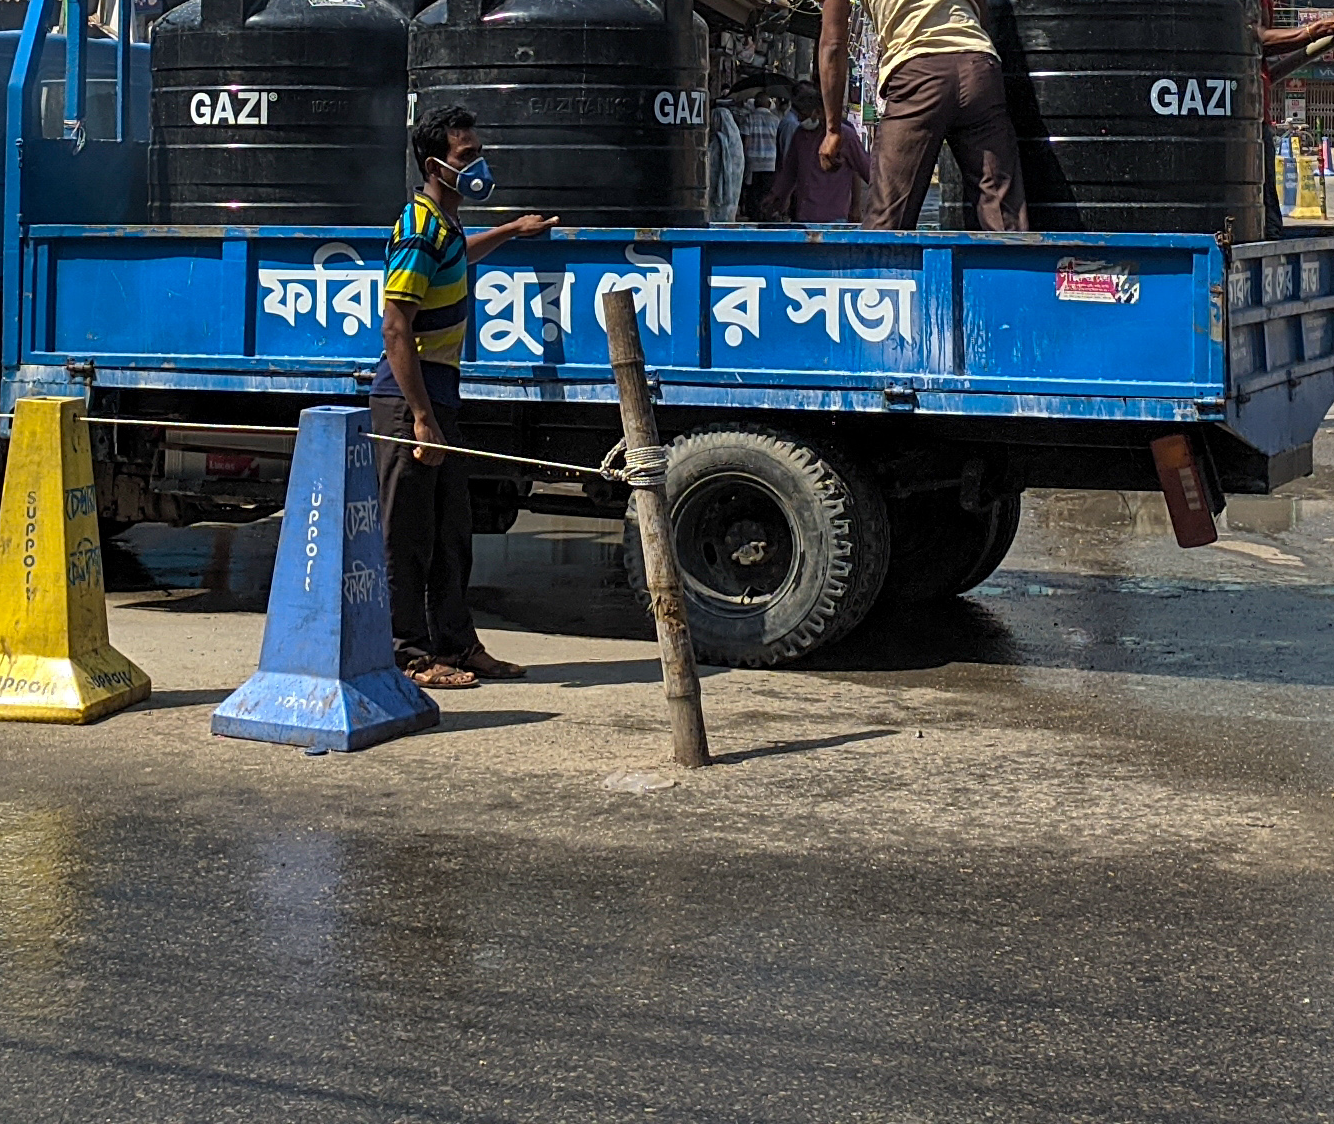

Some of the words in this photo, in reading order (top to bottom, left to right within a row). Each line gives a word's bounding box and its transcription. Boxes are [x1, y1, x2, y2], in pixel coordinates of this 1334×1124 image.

[258, 242, 386, 336] ফরি
[780, 276, 917, 344] সভা
[346, 495, 381, 541] চেম্বার
